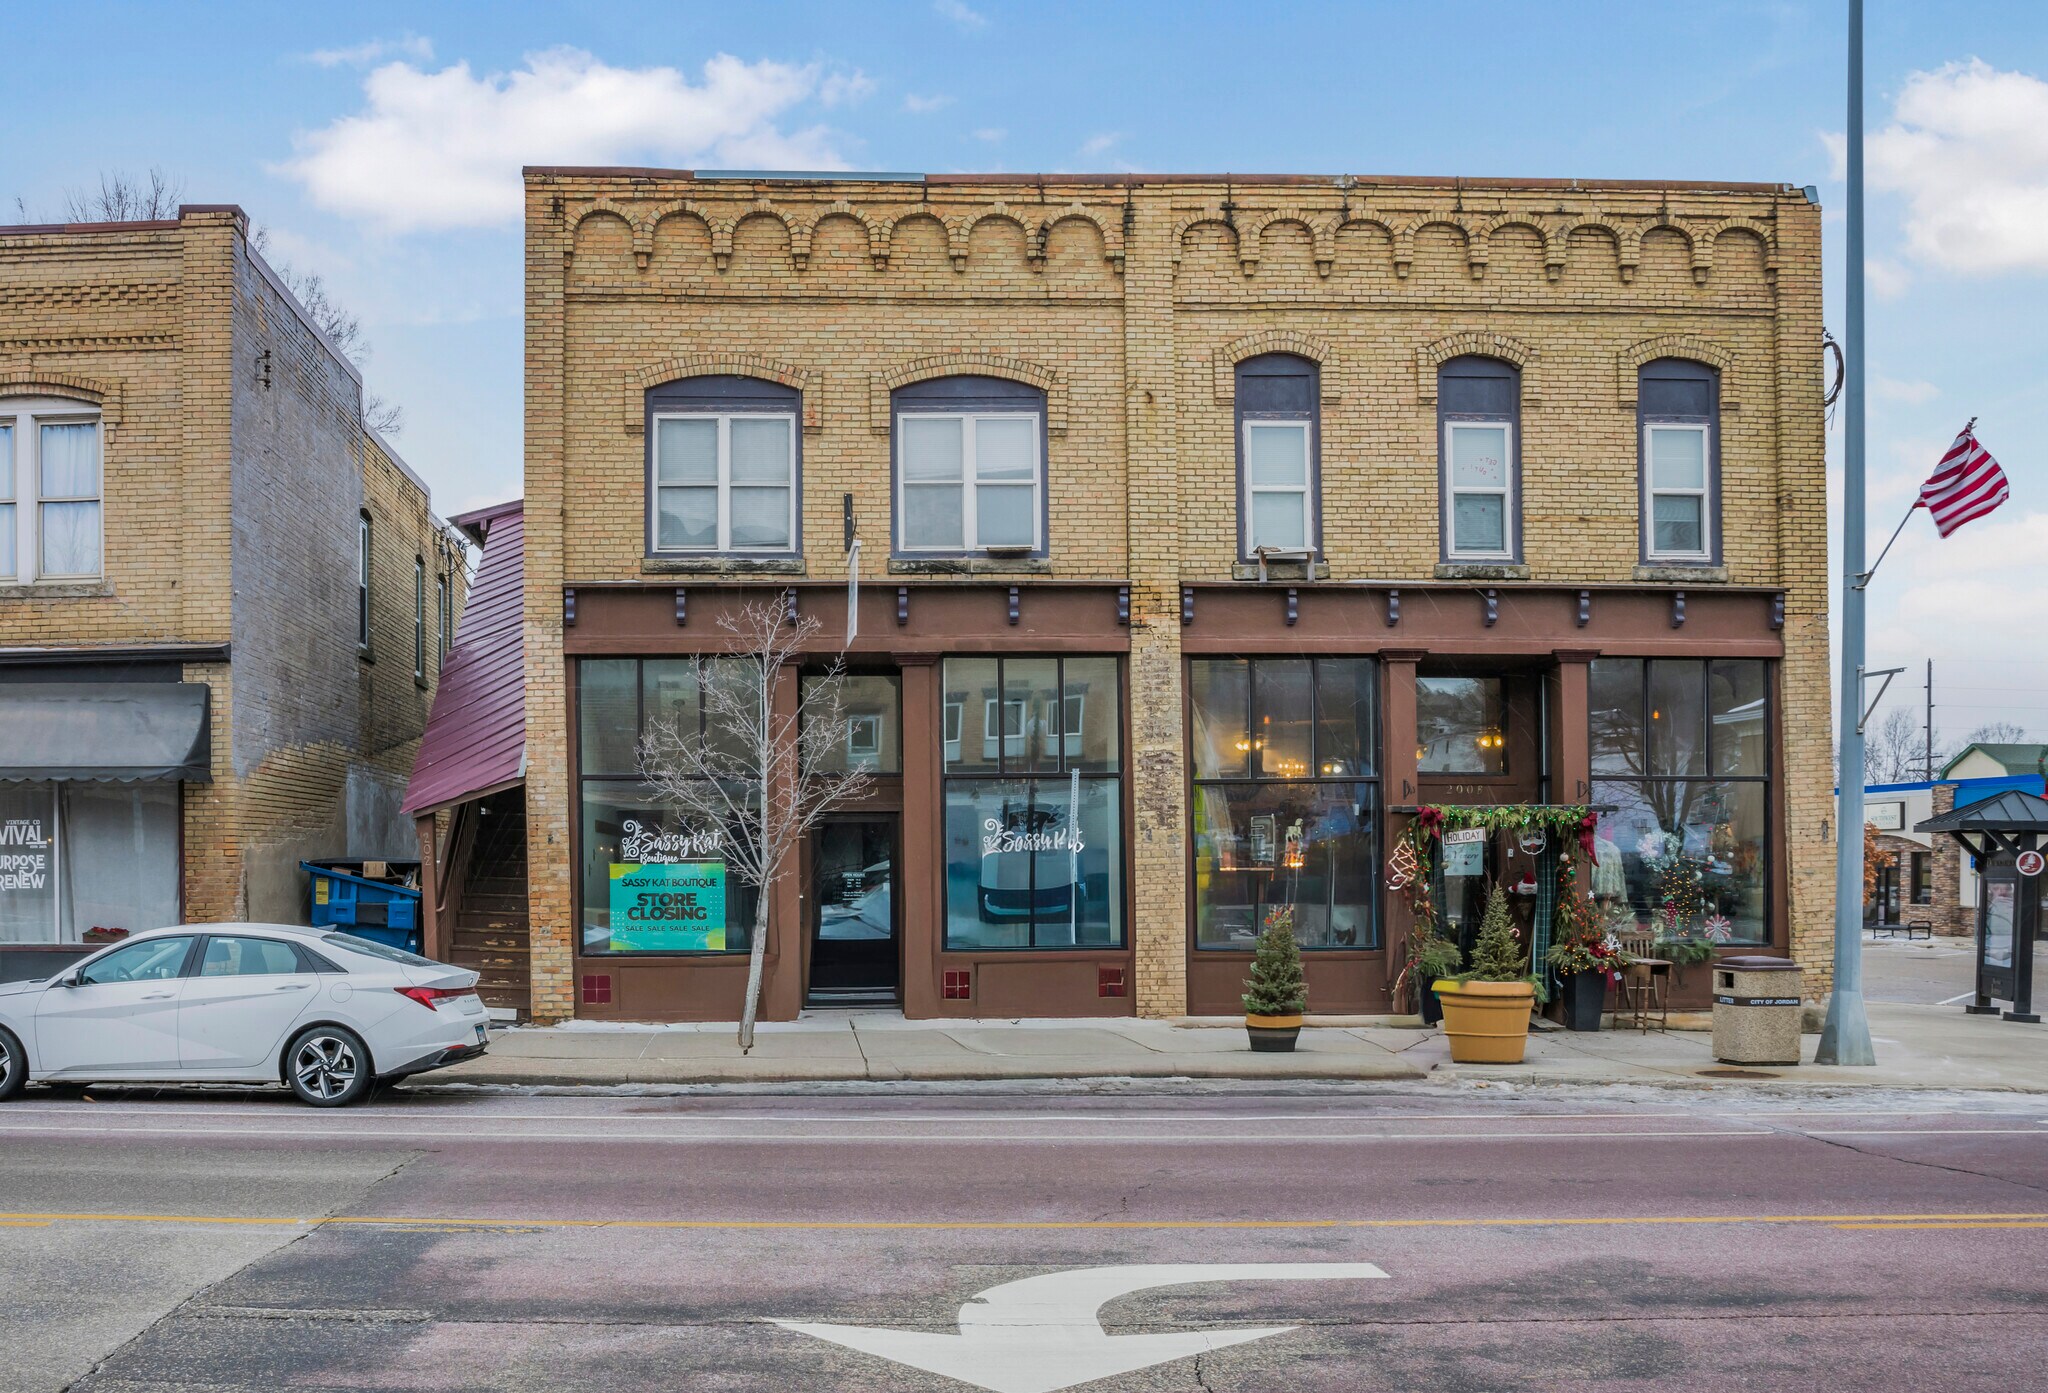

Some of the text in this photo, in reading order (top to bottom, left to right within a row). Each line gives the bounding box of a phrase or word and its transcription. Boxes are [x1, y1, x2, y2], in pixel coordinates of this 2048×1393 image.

[640, 829, 722, 857] Sassy Kat
[1446, 830, 1481, 843] HOLIDAY
[423, 832, 431, 866] 202
[640, 851, 679, 866] Boutique
[621, 878, 717, 888] SASSY KAT BOUTIQUE
[636, 893, 698, 907] STORE
[627, 907, 707, 921] CLOSING
